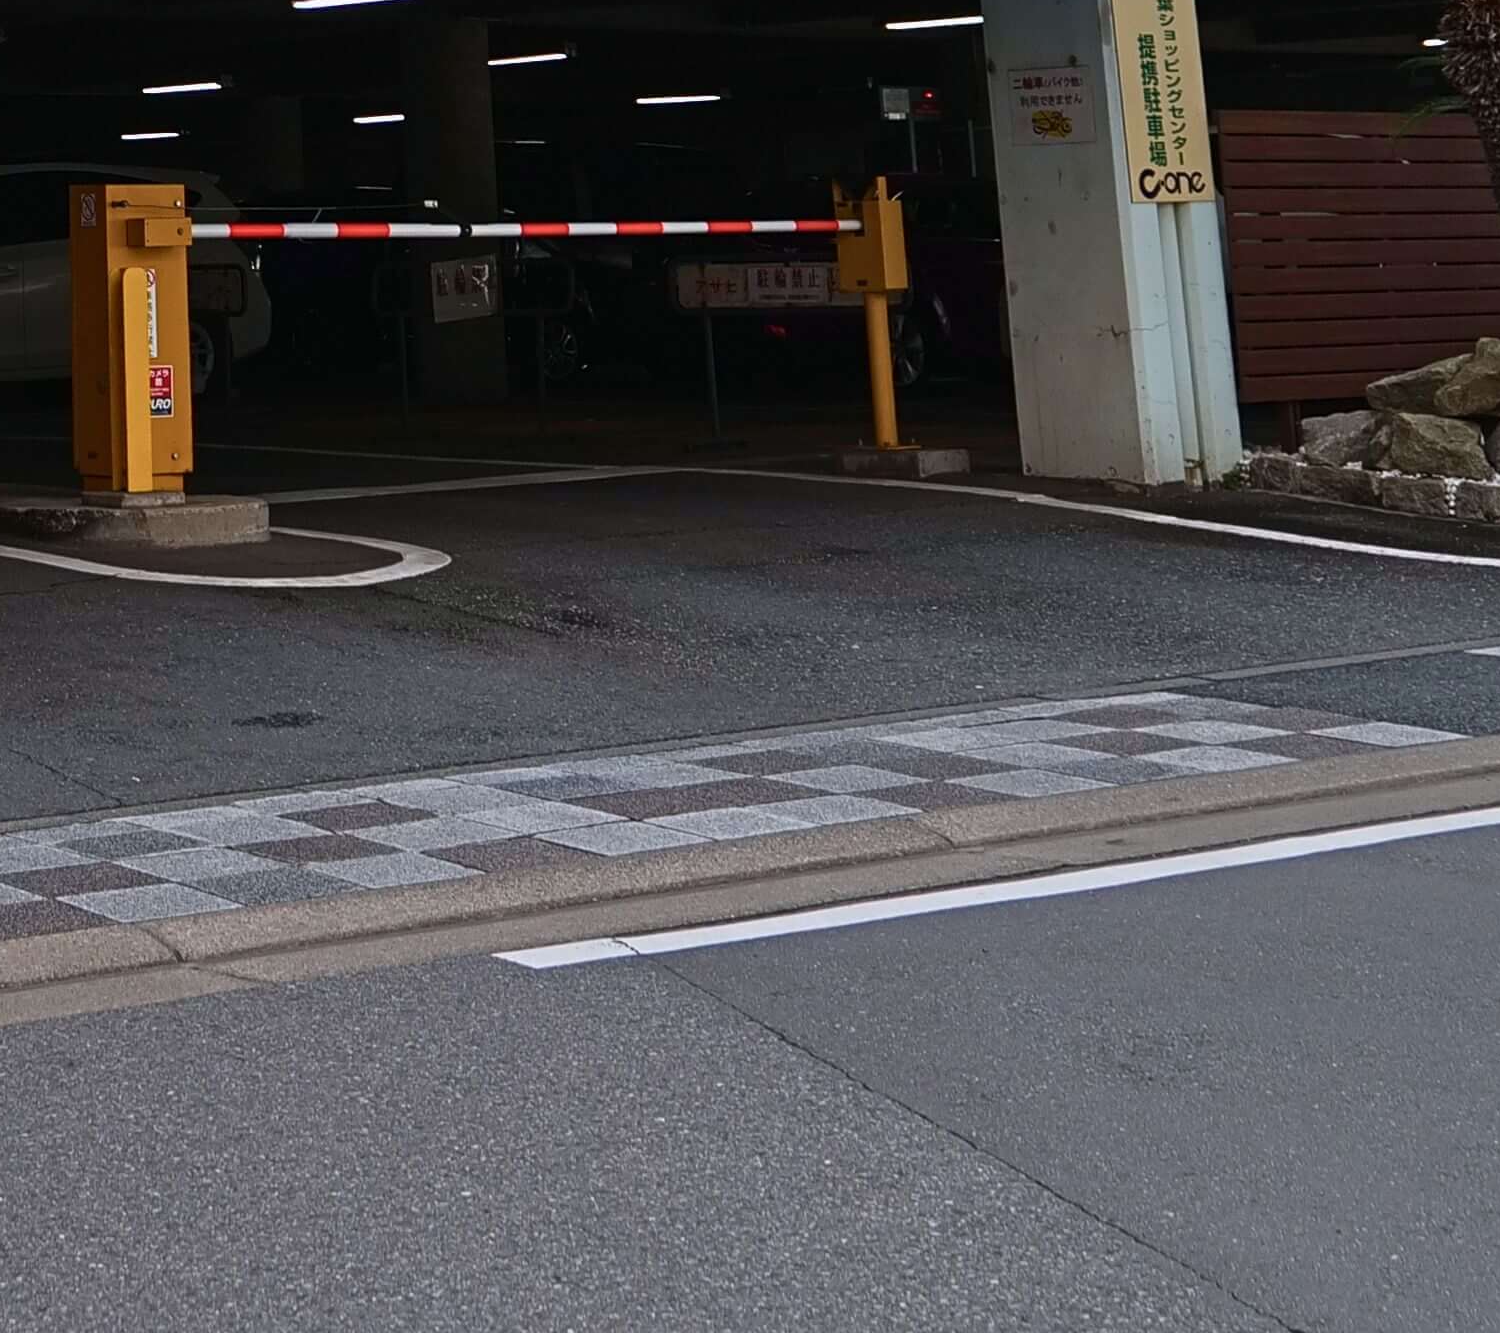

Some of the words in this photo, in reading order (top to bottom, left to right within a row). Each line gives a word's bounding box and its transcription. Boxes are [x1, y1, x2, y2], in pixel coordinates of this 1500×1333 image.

[1137, 33, 1168, 167] 提携駐車場
